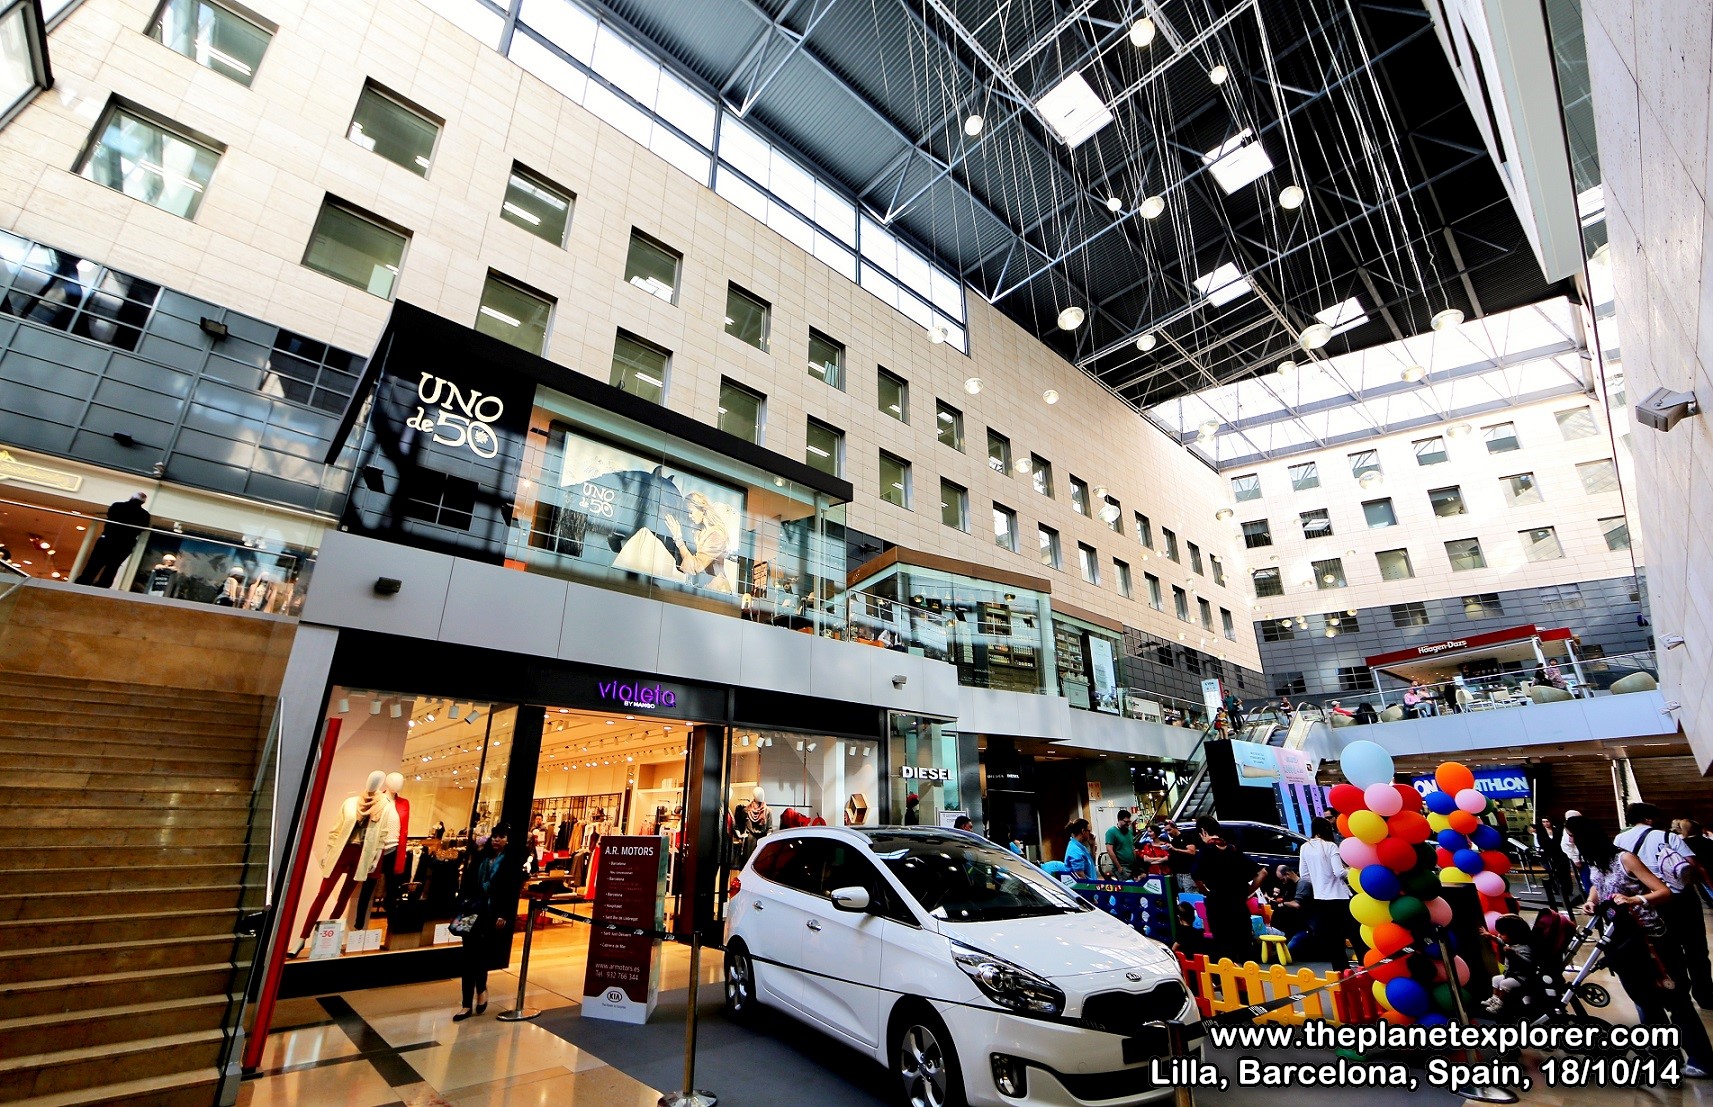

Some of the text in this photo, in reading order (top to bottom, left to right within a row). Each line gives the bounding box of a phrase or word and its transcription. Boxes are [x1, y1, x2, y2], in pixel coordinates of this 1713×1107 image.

[418, 371, 504, 423] UNO
[406, 406, 499, 459] de 50
[583, 482, 615, 501] UNO
[589, 499, 614, 518] 50
[598, 680, 676, 707] violeta
[633, 701, 656, 709] MANGO
[902, 765, 954, 780] DIESEL
[1474, 776, 1530, 792] ATHLON
[604, 846, 654, 856] A.R. MOTORS
